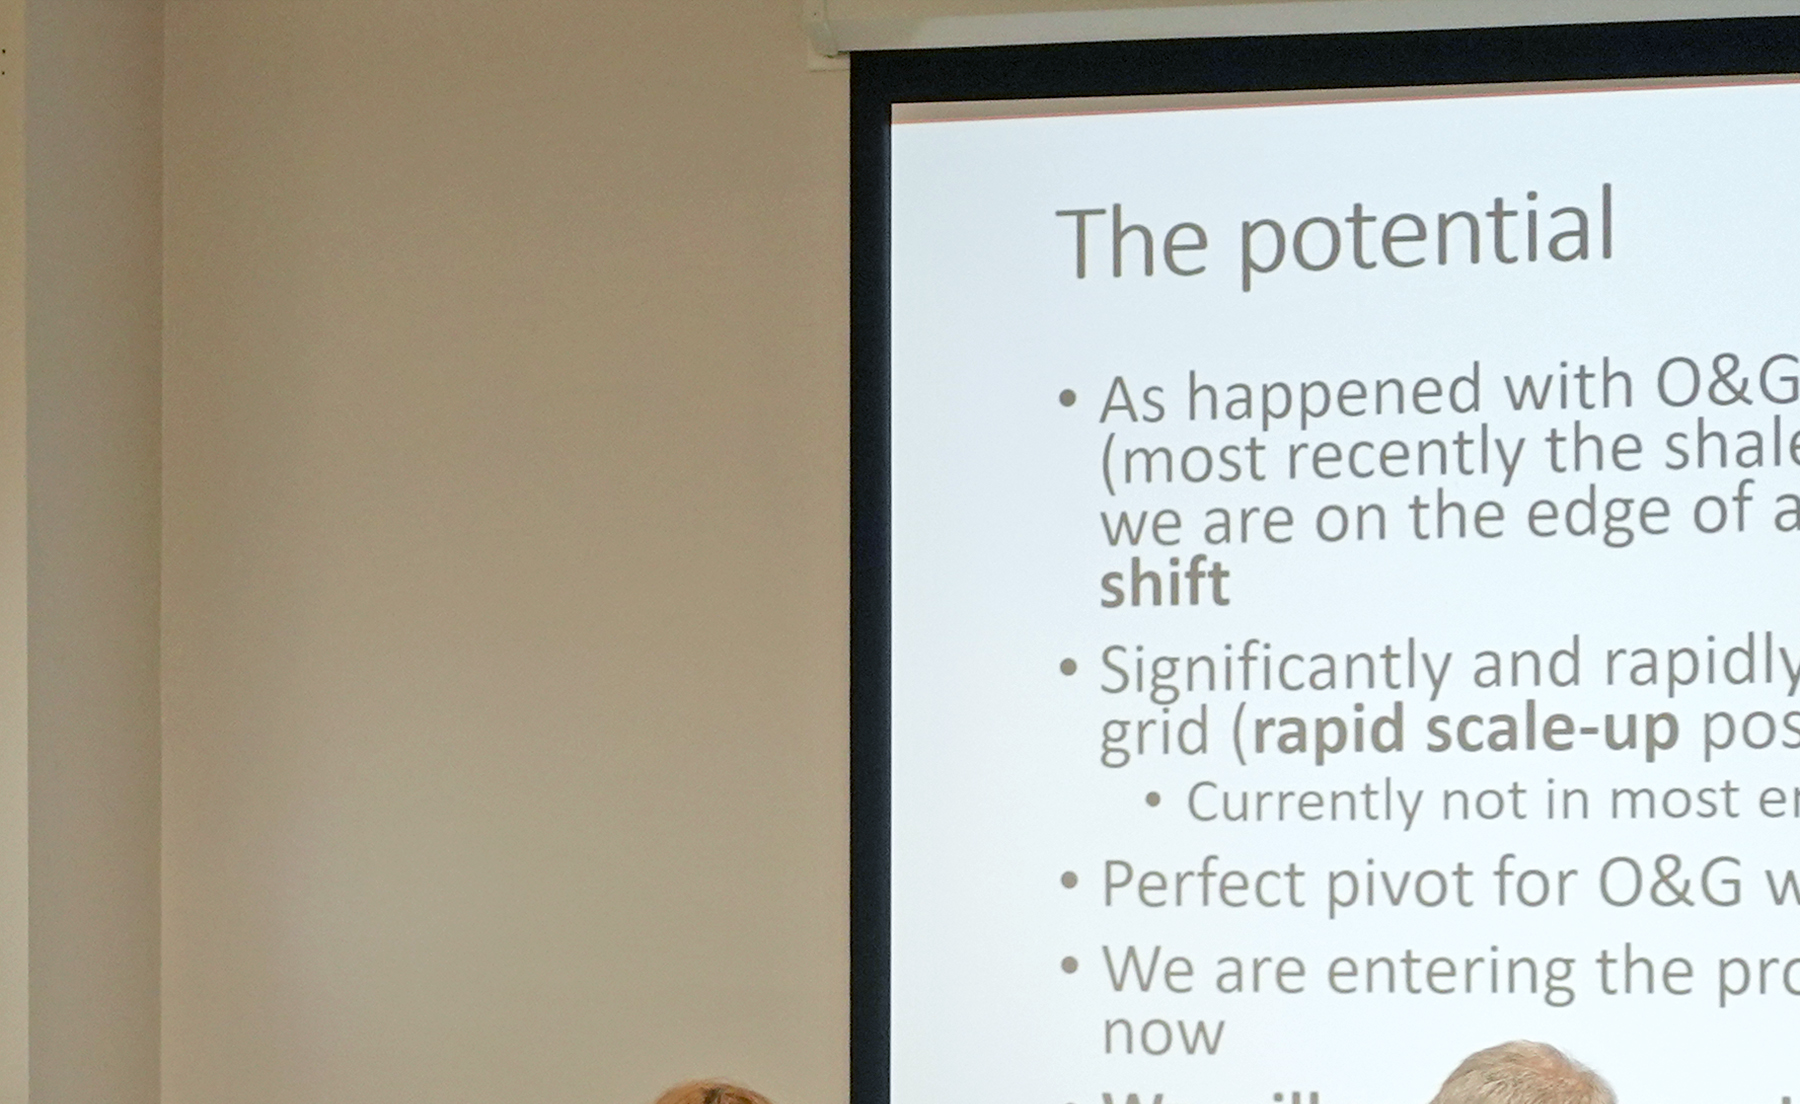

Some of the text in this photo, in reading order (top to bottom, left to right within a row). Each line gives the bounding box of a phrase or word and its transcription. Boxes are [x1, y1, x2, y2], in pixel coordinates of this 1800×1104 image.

[1055, 183, 1612, 292] The potential
[1099, 353, 1799, 432] As happened with O&G
[1103, 433, 1266, 496] (most
[1289, 423, 1525, 487] recently
[1545, 420, 1642, 473] the
[1100, 509, 1181, 546] we
[1204, 506, 1293, 545] are
[1316, 504, 1385, 542] on
[1408, 487, 1504, 540] the
[1528, 483, 1670, 548] edge
[1694, 478, 1755, 534] of
[1101, 554, 1230, 608] shift
[1101, 637, 1452, 705] Significantly
[1474, 634, 1579, 688] and
[1101, 703, 1207, 768] grid
[1233, 701, 1403, 766] (rapid
[1427, 699, 1679, 763] scale-up
[1188, 777, 1423, 831] Currently
[1444, 782, 1527, 820] not
[1548, 780, 1588, 819] in
[1612, 780, 1739, 819] most
[1105, 855, 1305, 907] Perfect
[1329, 857, 1473, 919] pivot
[1493, 853, 1578, 907] for
[1600, 854, 1740, 907] O&G
[1102, 946, 1193, 993] We
[1216, 957, 1305, 994] are
[1328, 949, 1576, 1007] entering
[1596, 942, 1693, 995] the
[1105, 1019, 1225, 1055] now
